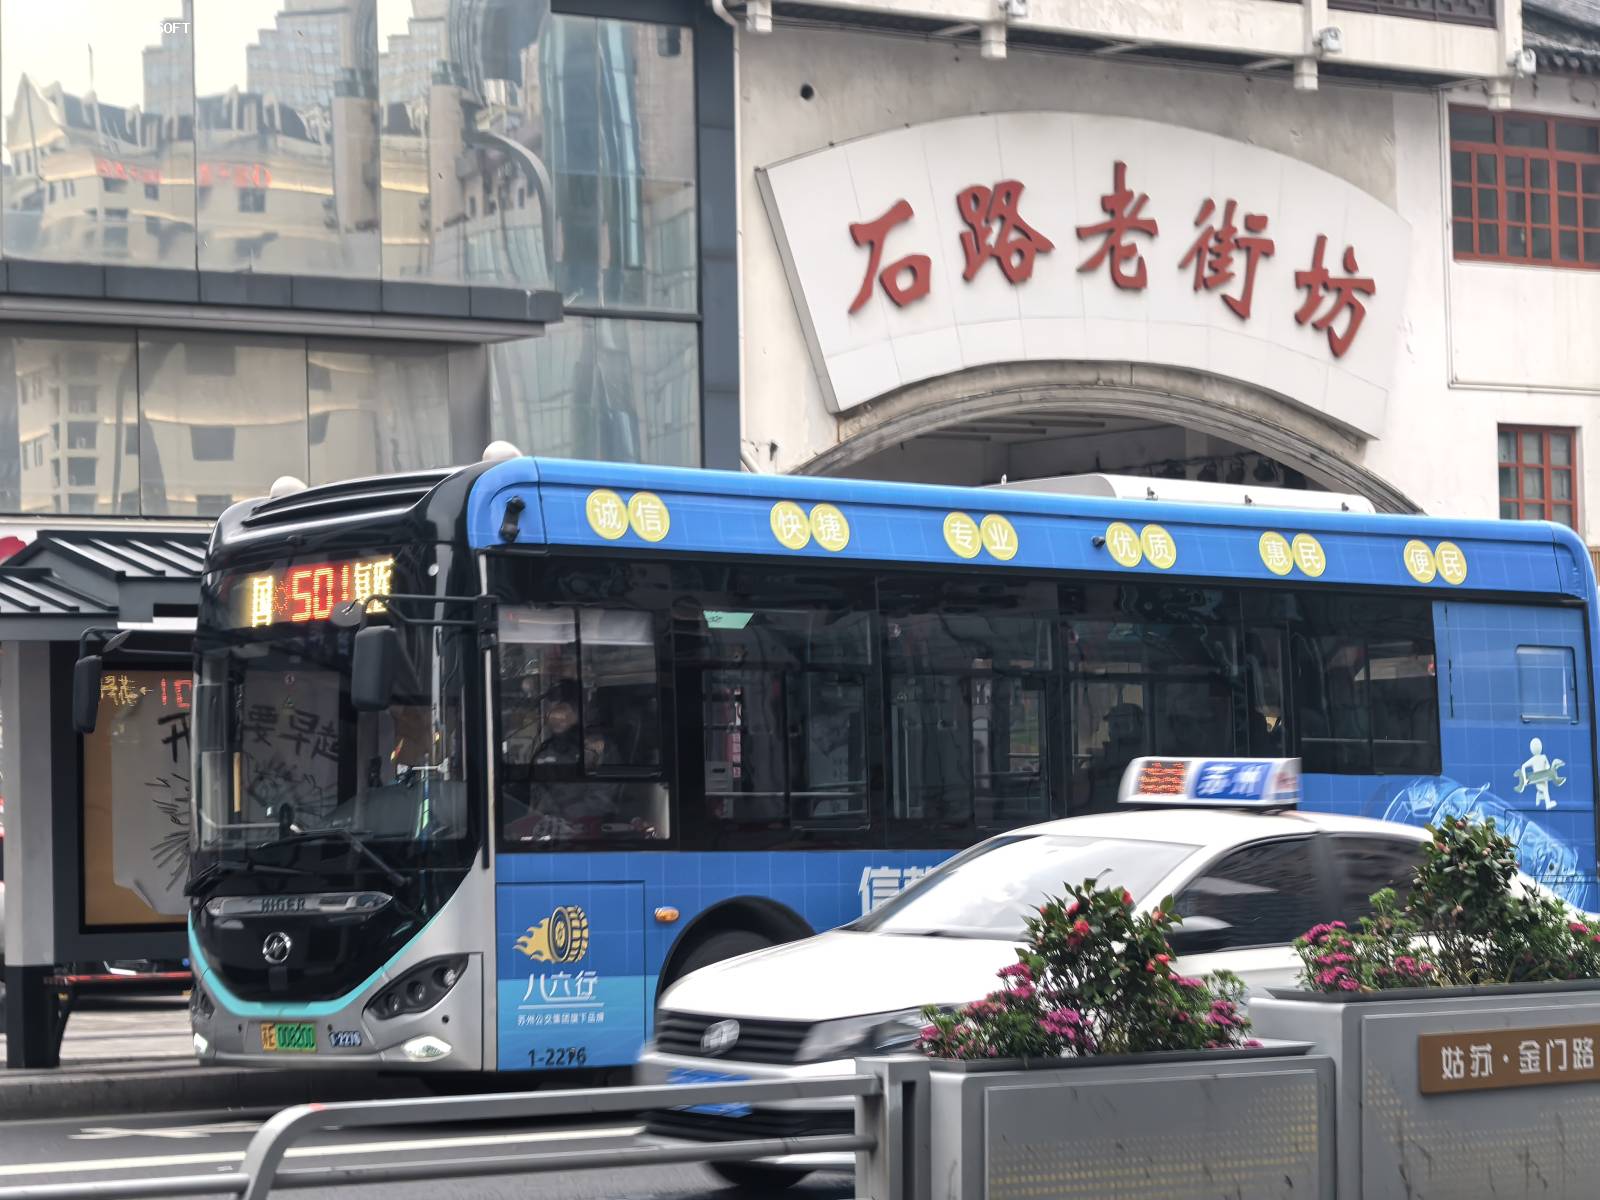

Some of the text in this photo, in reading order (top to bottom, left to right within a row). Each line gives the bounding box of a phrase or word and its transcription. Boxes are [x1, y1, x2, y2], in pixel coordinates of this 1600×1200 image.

[847, 160, 1378, 359] 石路老街坊
[590, 496, 1464, 581] 诚信 快捷 专业 优质 惠民 便民
[523, 970, 599, 1002] 八六行
[1440, 1037, 1595, 1080] 姑苏·金门路
